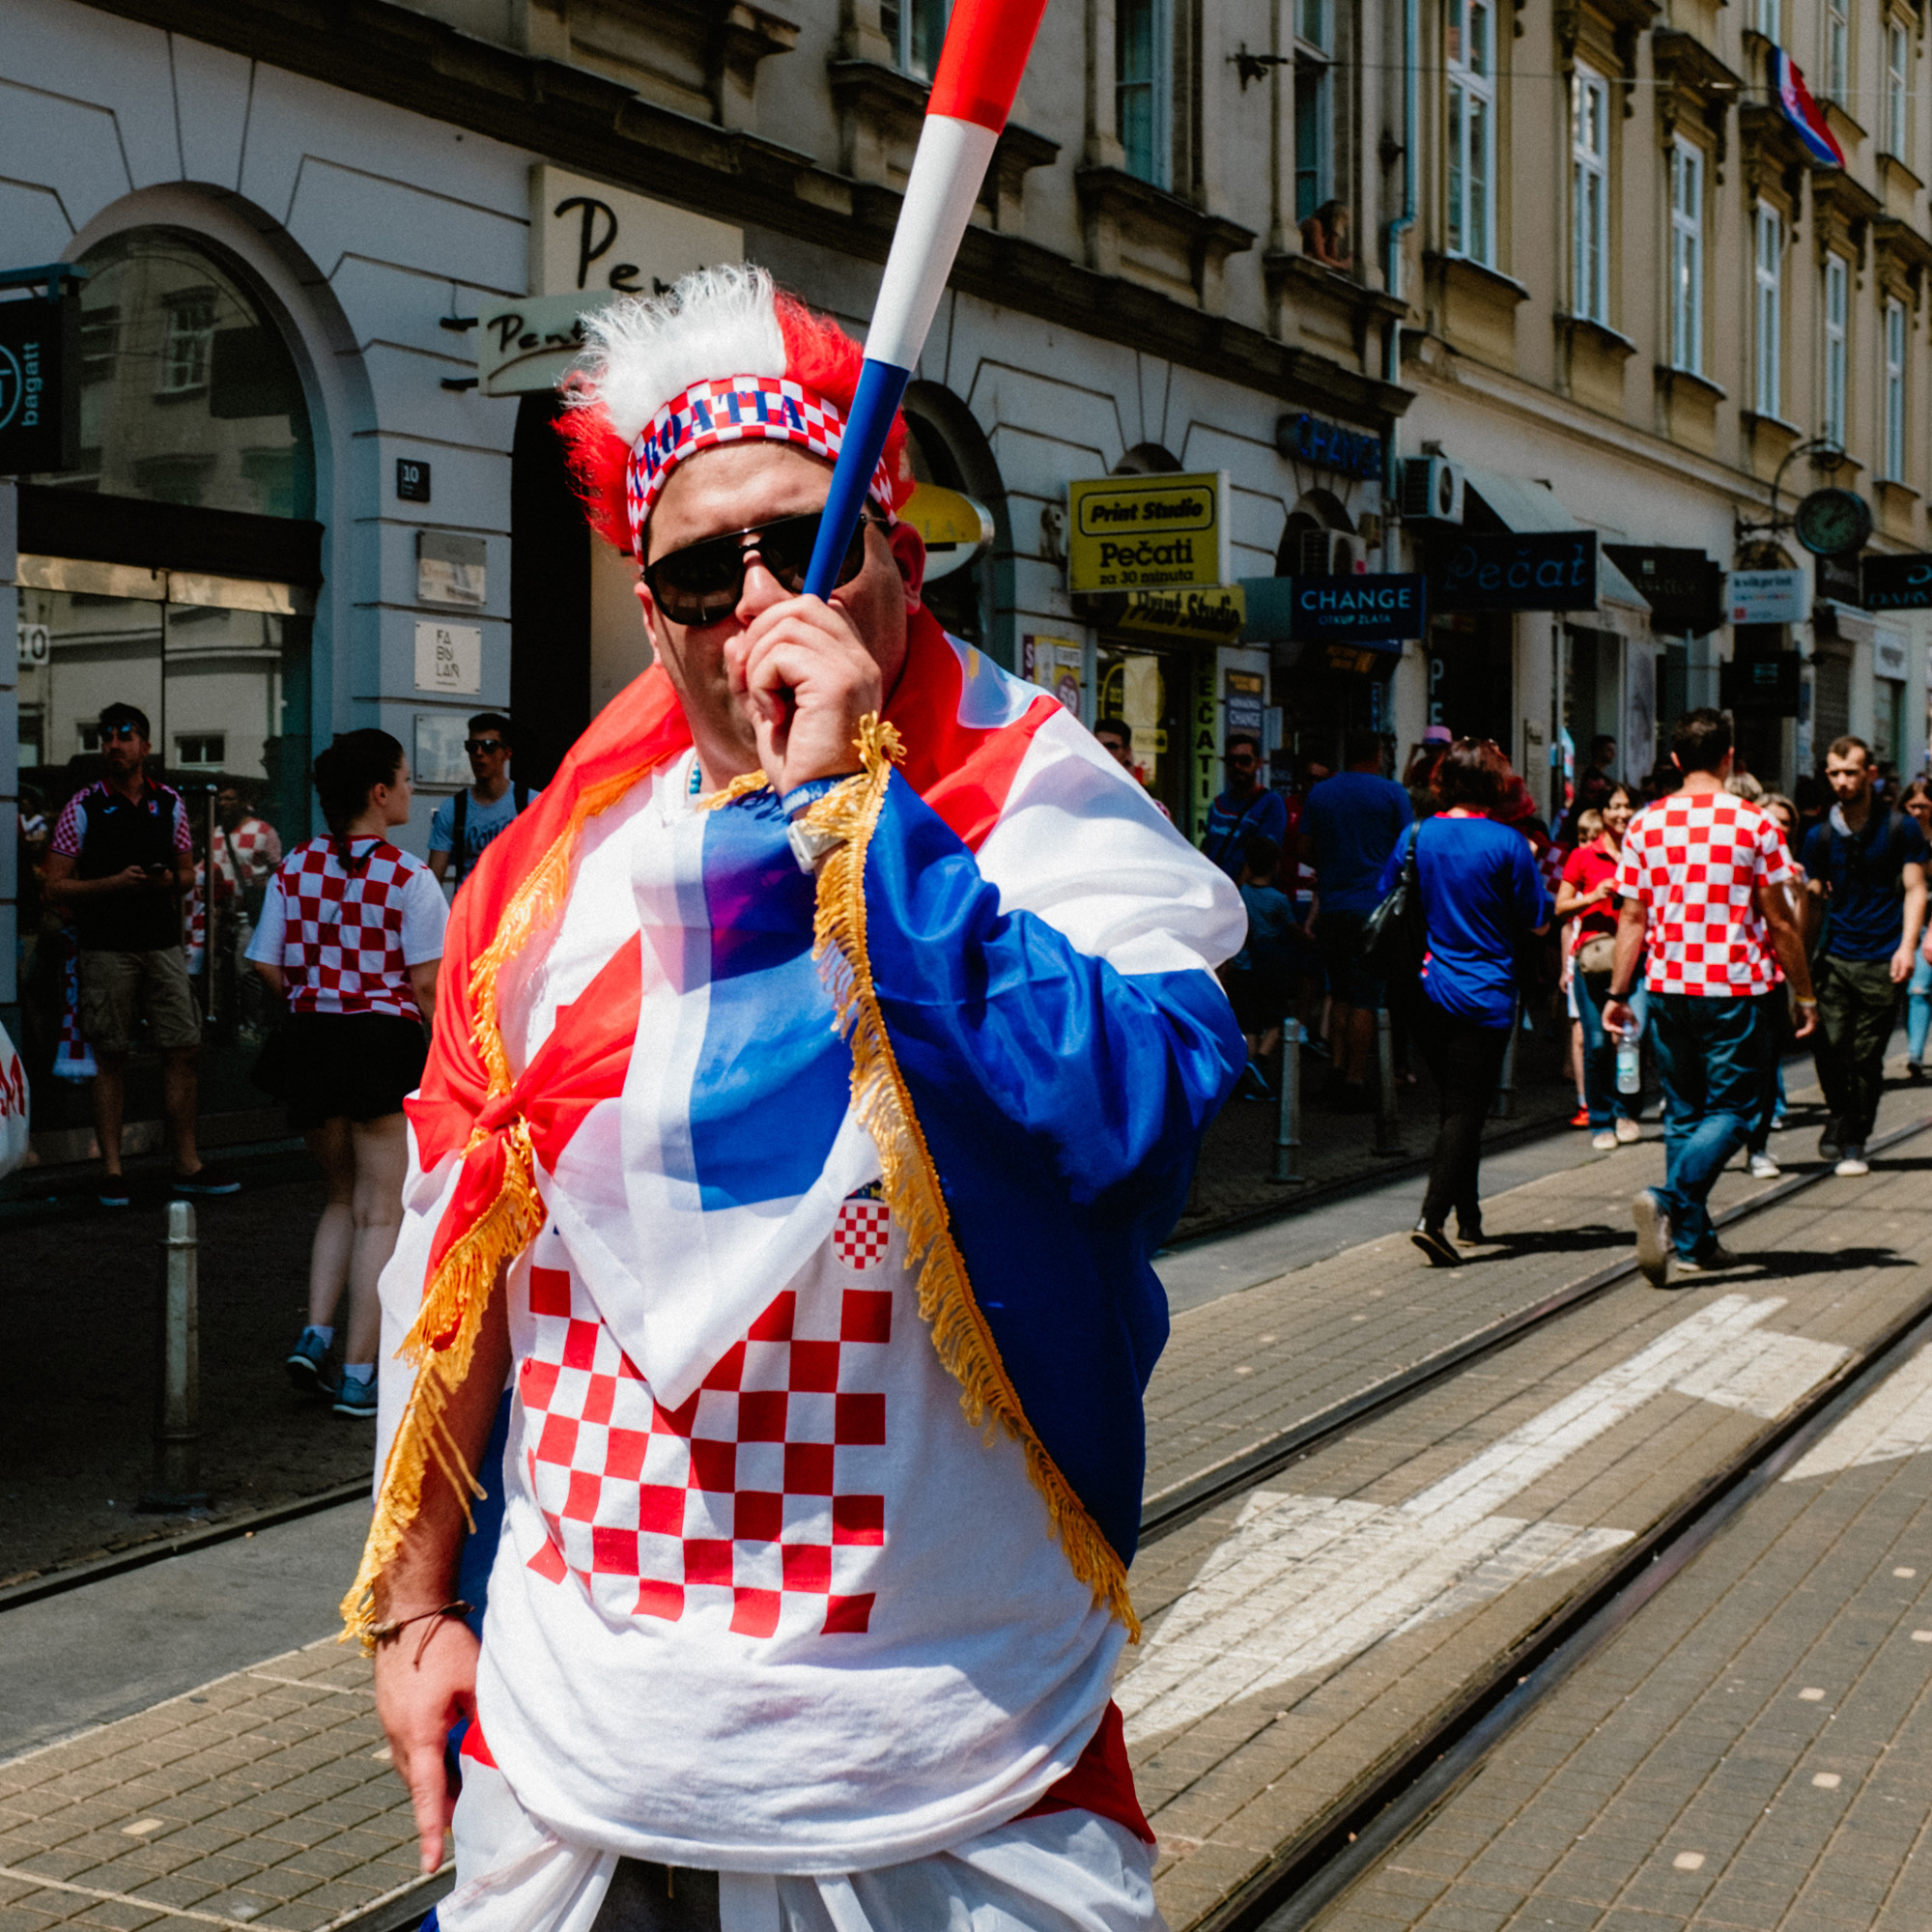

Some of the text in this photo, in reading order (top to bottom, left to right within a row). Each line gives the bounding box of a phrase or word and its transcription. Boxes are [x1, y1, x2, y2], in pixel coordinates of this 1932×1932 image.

[21, 341, 43, 427] bagatt
[635, 390, 804, 498] CROATIA
[404, 465, 419, 483] 10
[1091, 497, 1203, 523] Print Studio
[1100, 538, 1194, 568] Pečati
[1441, 543, 1586, 590] Pečat
[1100, 569, 1194, 584] za 30 minuta
[1300, 588, 1411, 611] CHANGE
